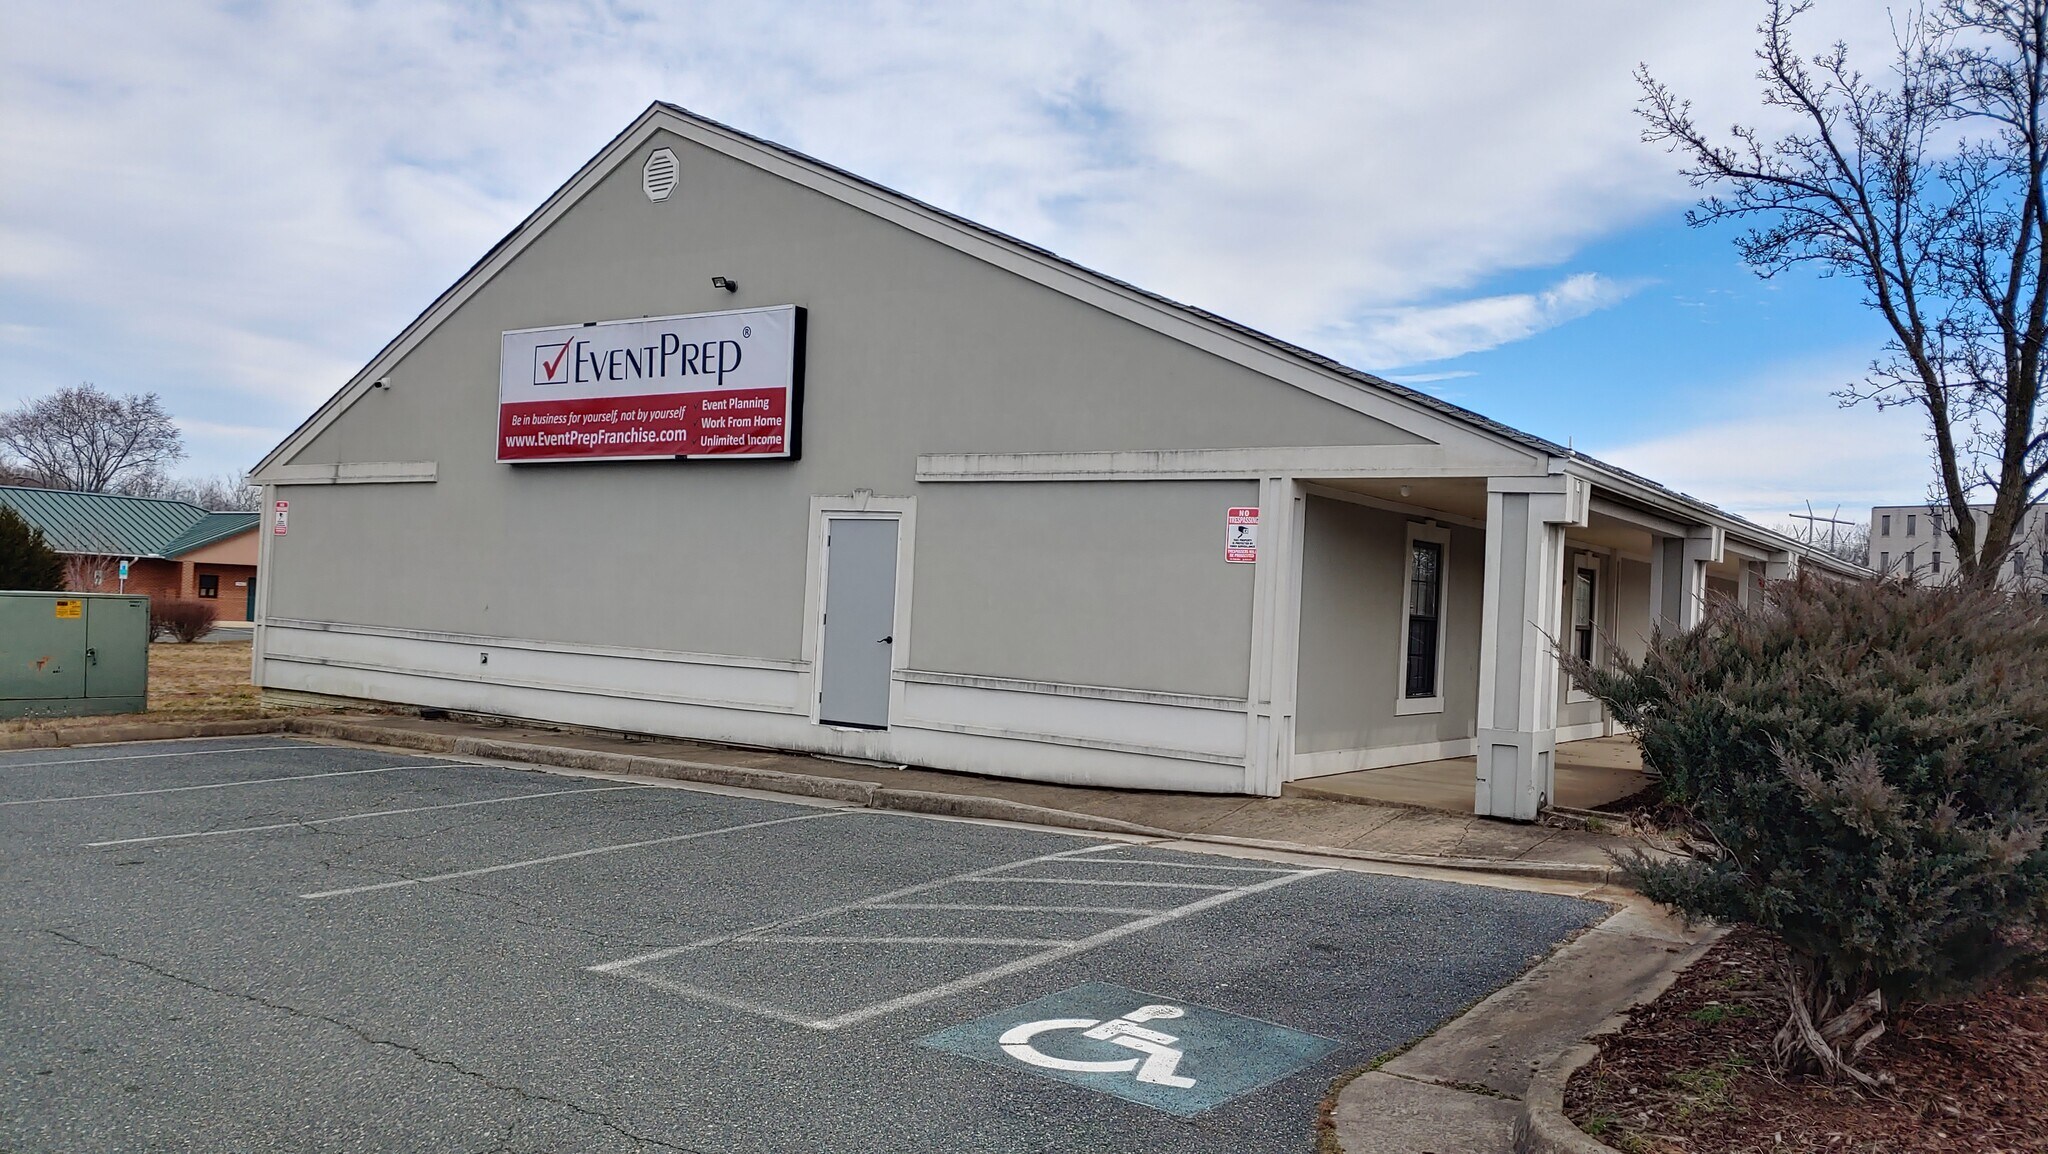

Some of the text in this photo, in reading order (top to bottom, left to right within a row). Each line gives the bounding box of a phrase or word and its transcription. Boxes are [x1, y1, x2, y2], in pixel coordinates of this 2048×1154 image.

[702, 396, 769, 411] Event Planning
[511, 405, 687, 426] Be in business for yourself, not by yourself
[701, 415, 782, 429] Work From Home
[505, 427, 687, 449] www.EventPrepFranchise.com
[700, 433, 782, 447] Unlimited Income
[1238, 509, 1250, 517] NO
